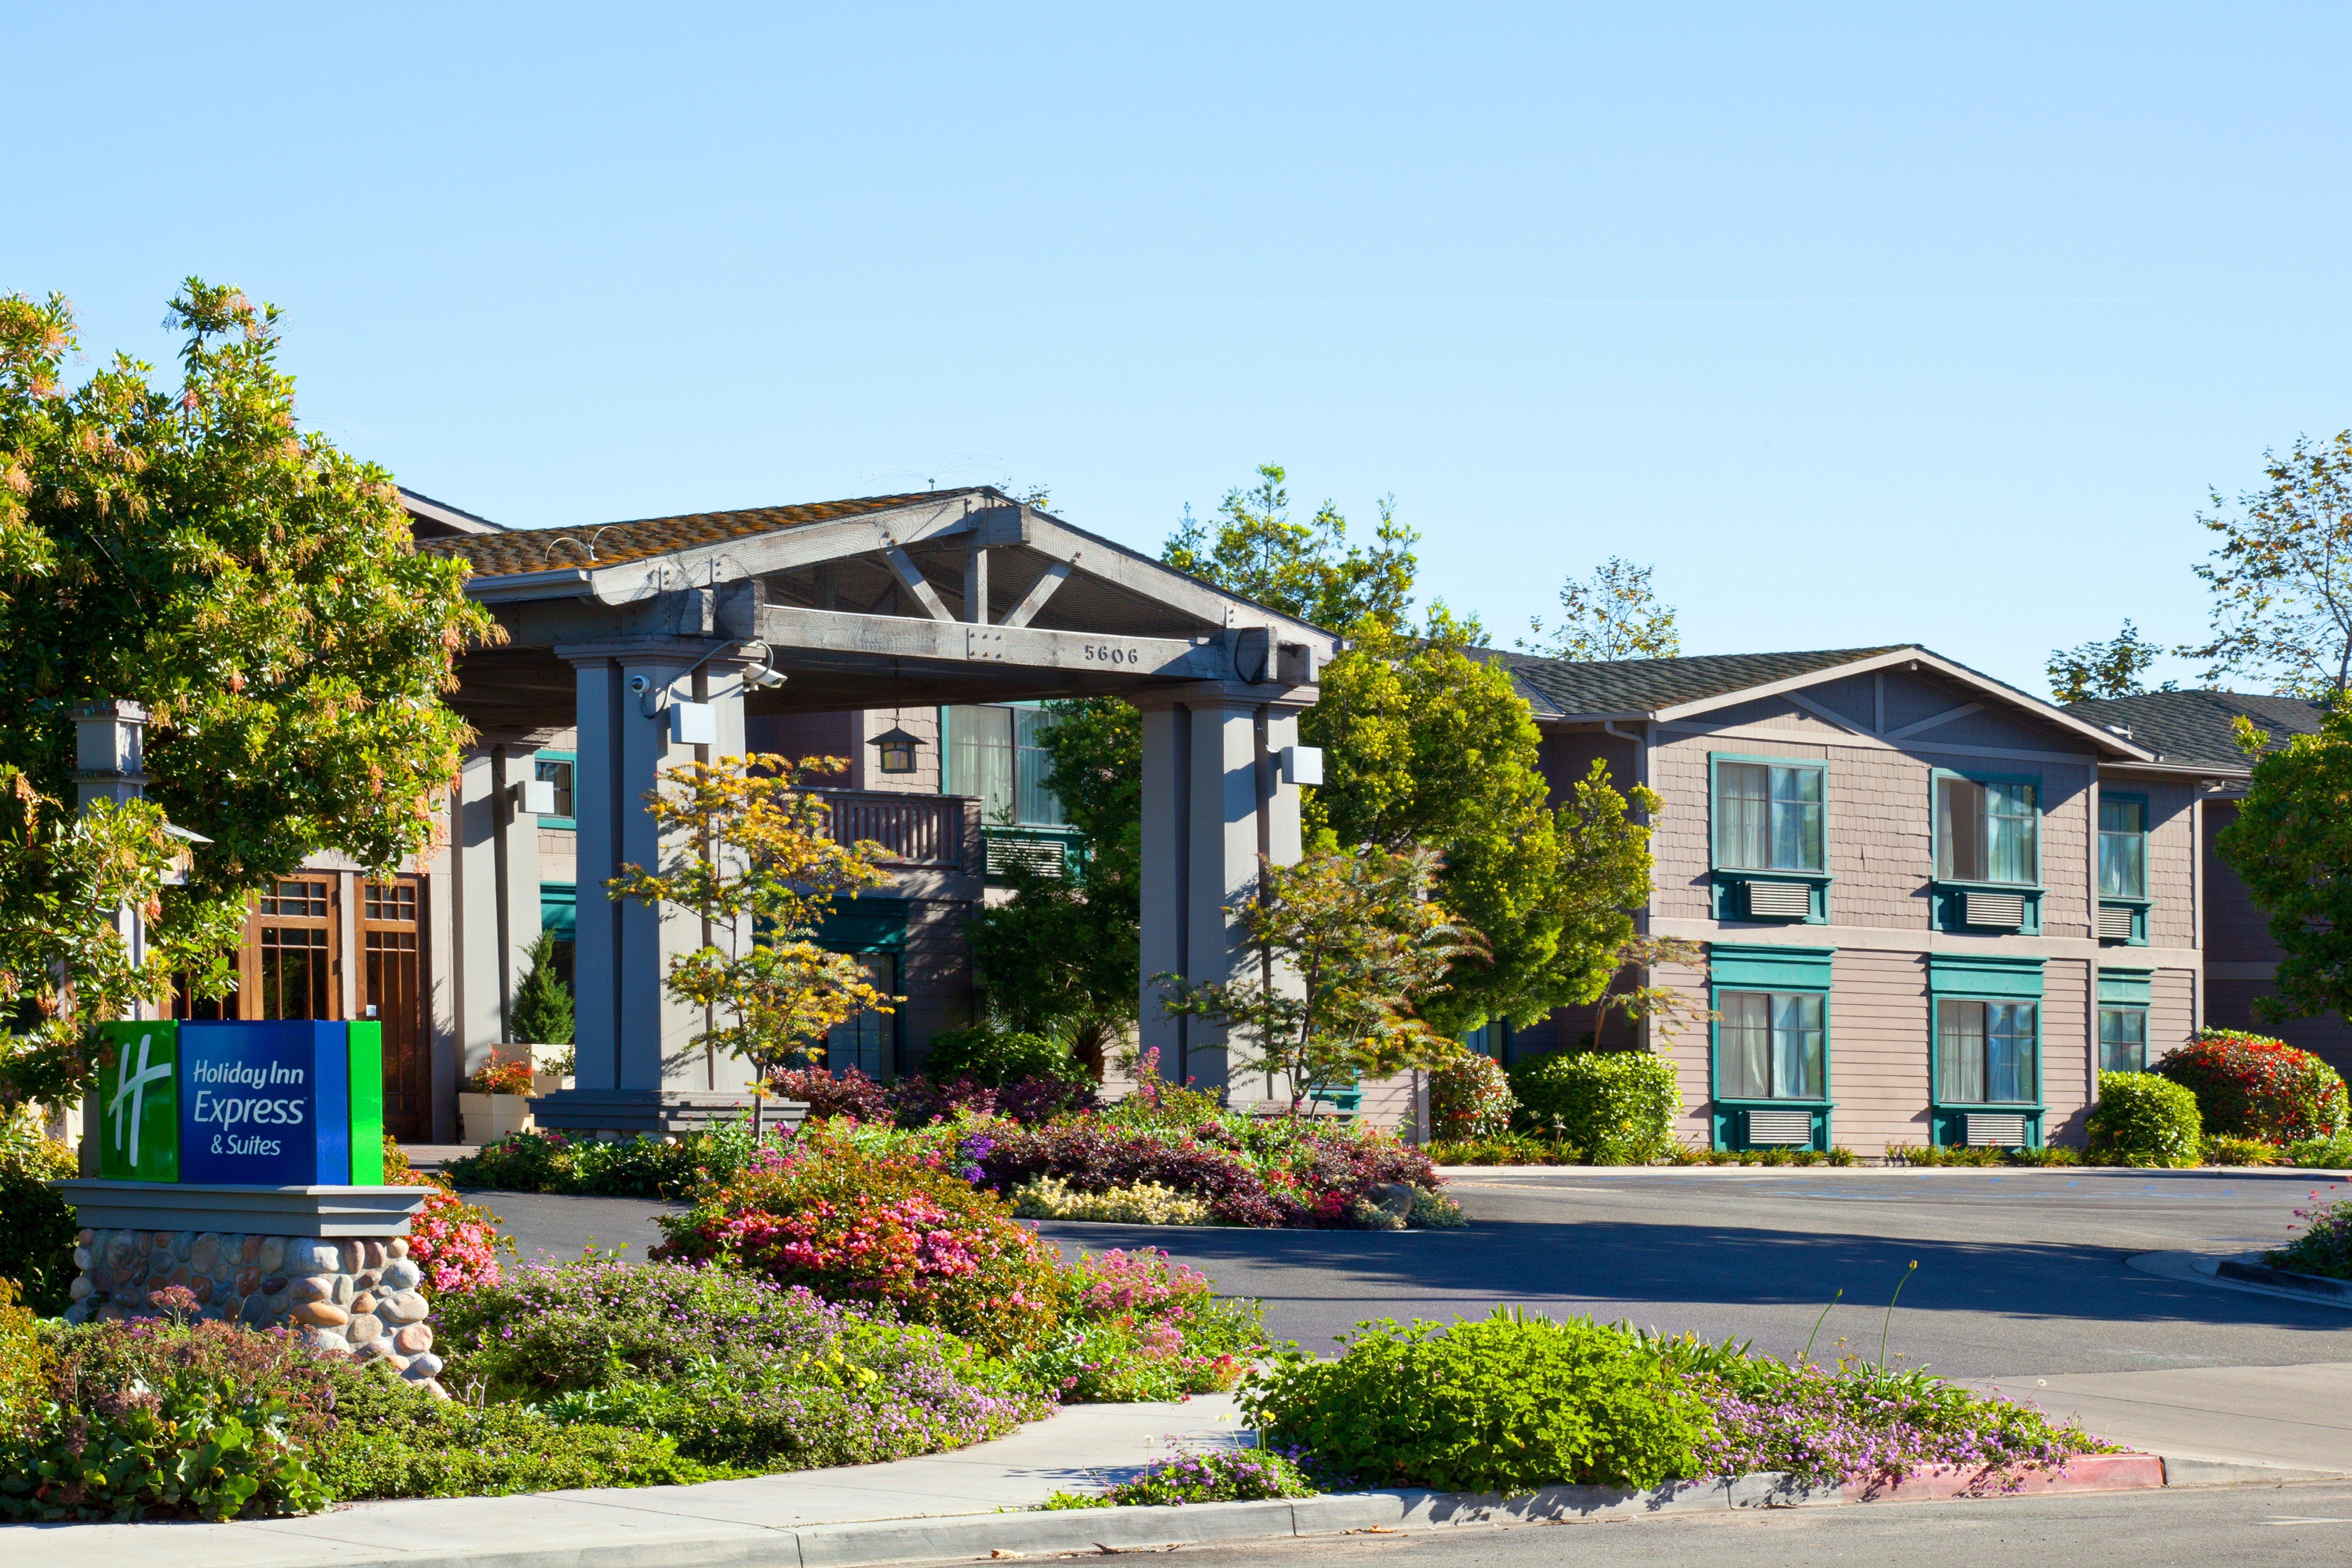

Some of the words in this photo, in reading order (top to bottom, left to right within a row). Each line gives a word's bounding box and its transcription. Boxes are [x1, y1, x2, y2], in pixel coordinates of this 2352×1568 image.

[1084, 645, 1138, 664] 5606
[193, 1060, 268, 1090] Holiday
[270, 1061, 304, 1084] Inn
[195, 1091, 304, 1131] Express
[211, 1135, 223, 1154] &
[227, 1135, 281, 1155] Suites
